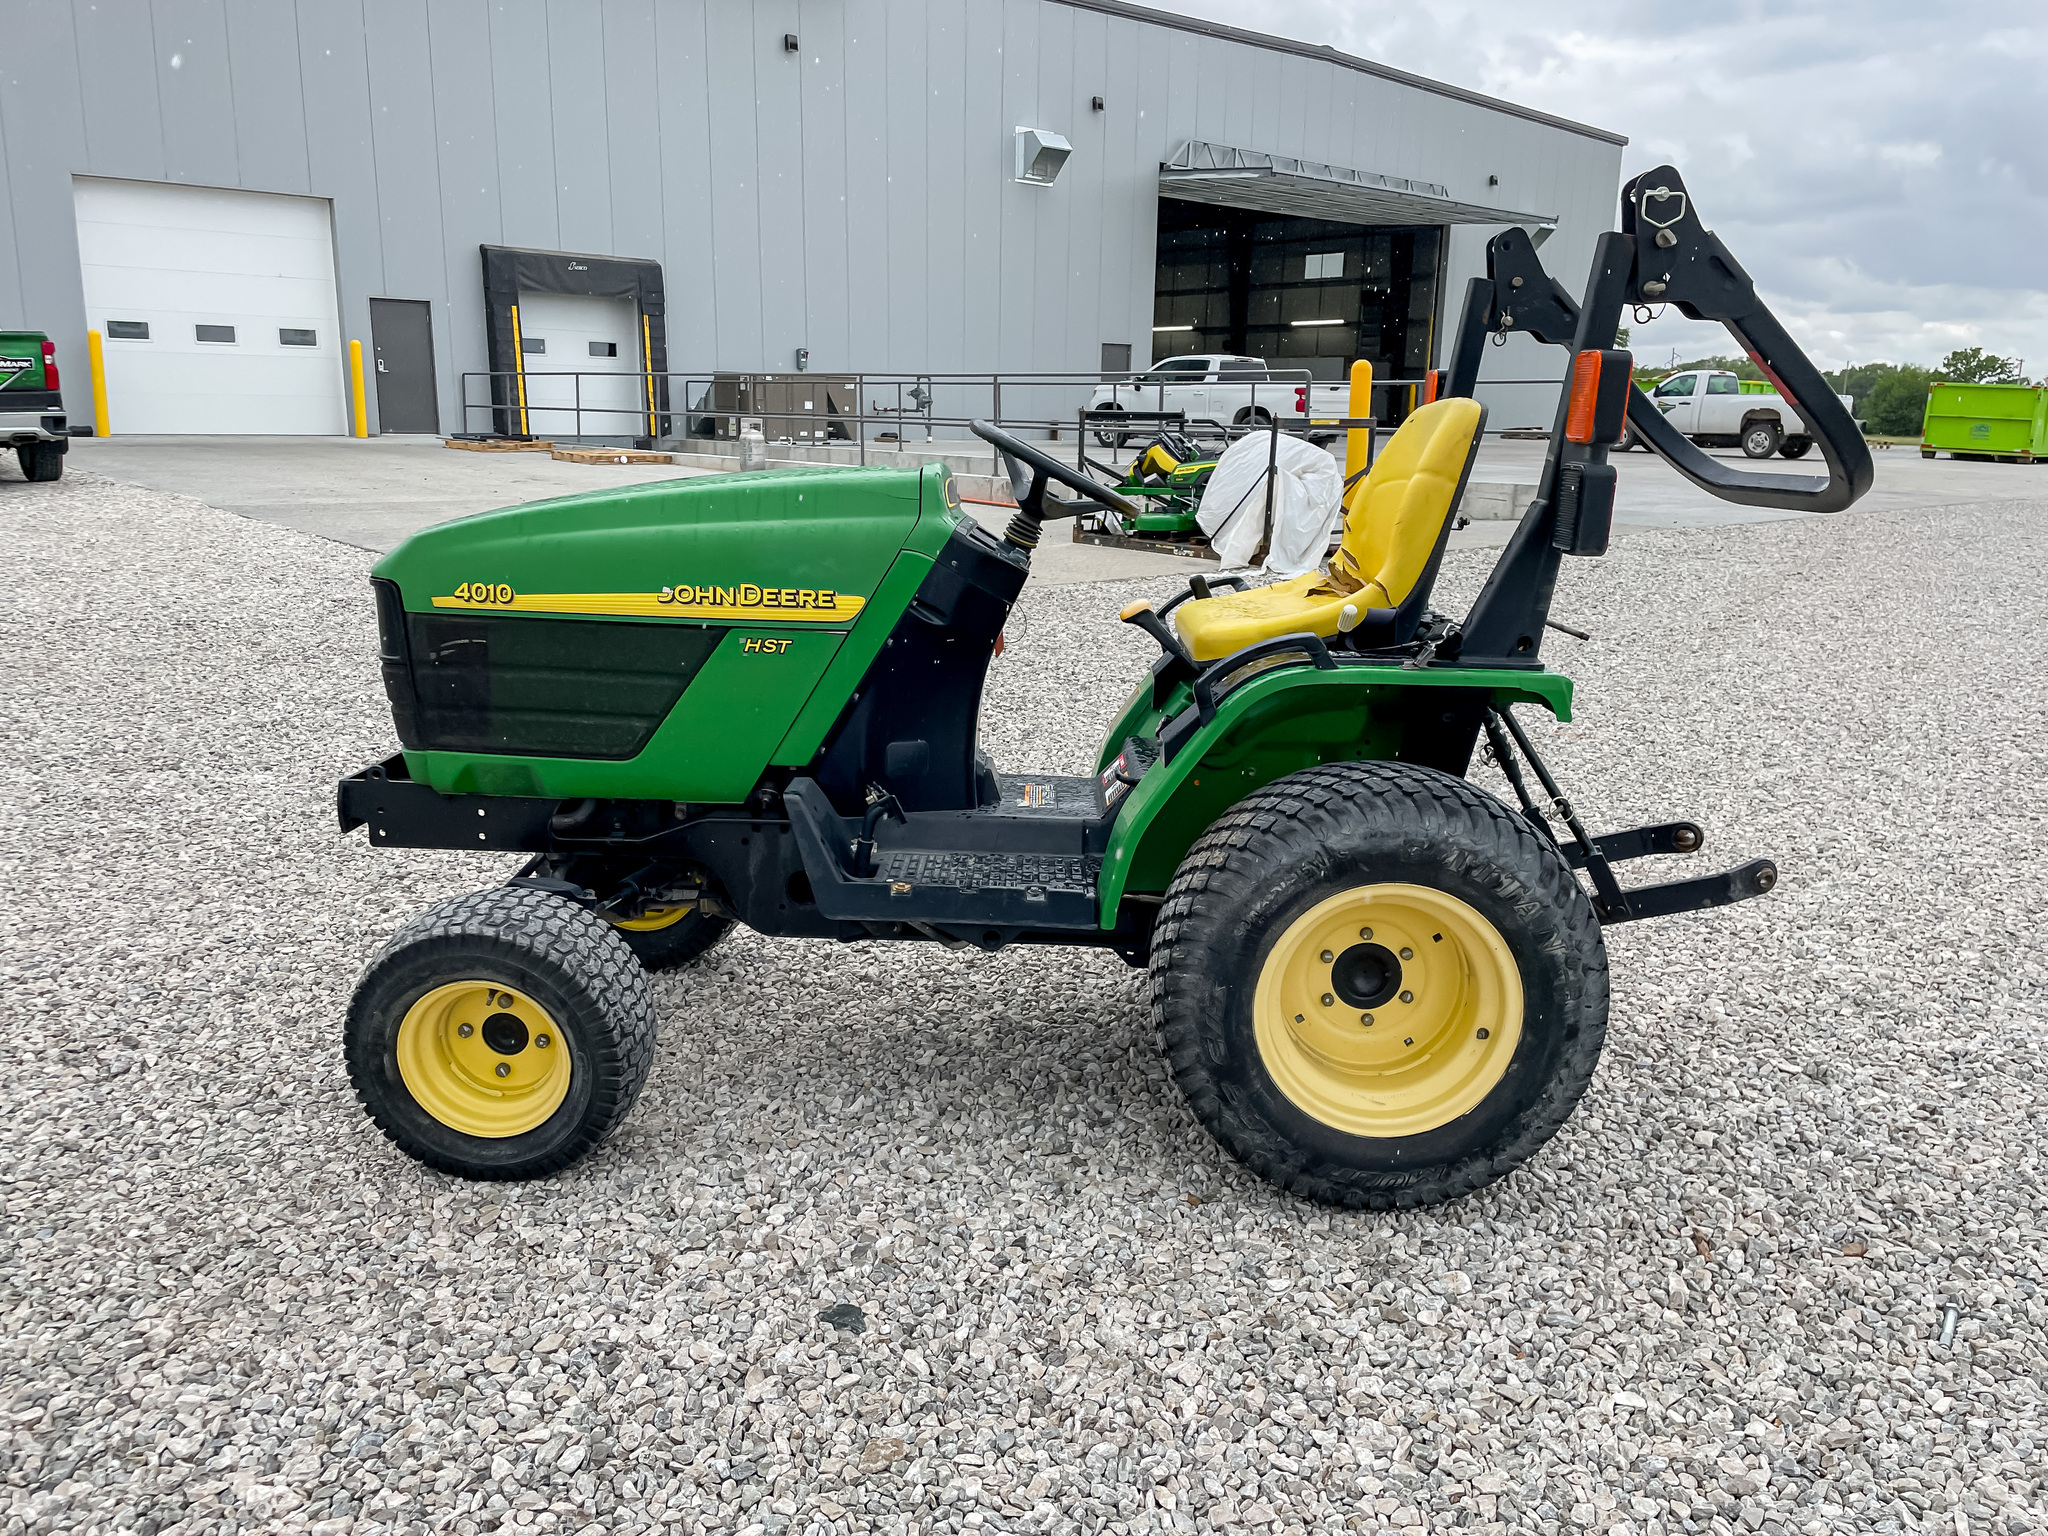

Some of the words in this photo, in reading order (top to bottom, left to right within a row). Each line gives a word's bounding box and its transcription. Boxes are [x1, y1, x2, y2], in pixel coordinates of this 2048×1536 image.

[454, 582, 514, 604] 4010
[657, 584, 737, 606] JOHN
[740, 583, 837, 609] DEERE
[743, 637, 793, 655] HST
